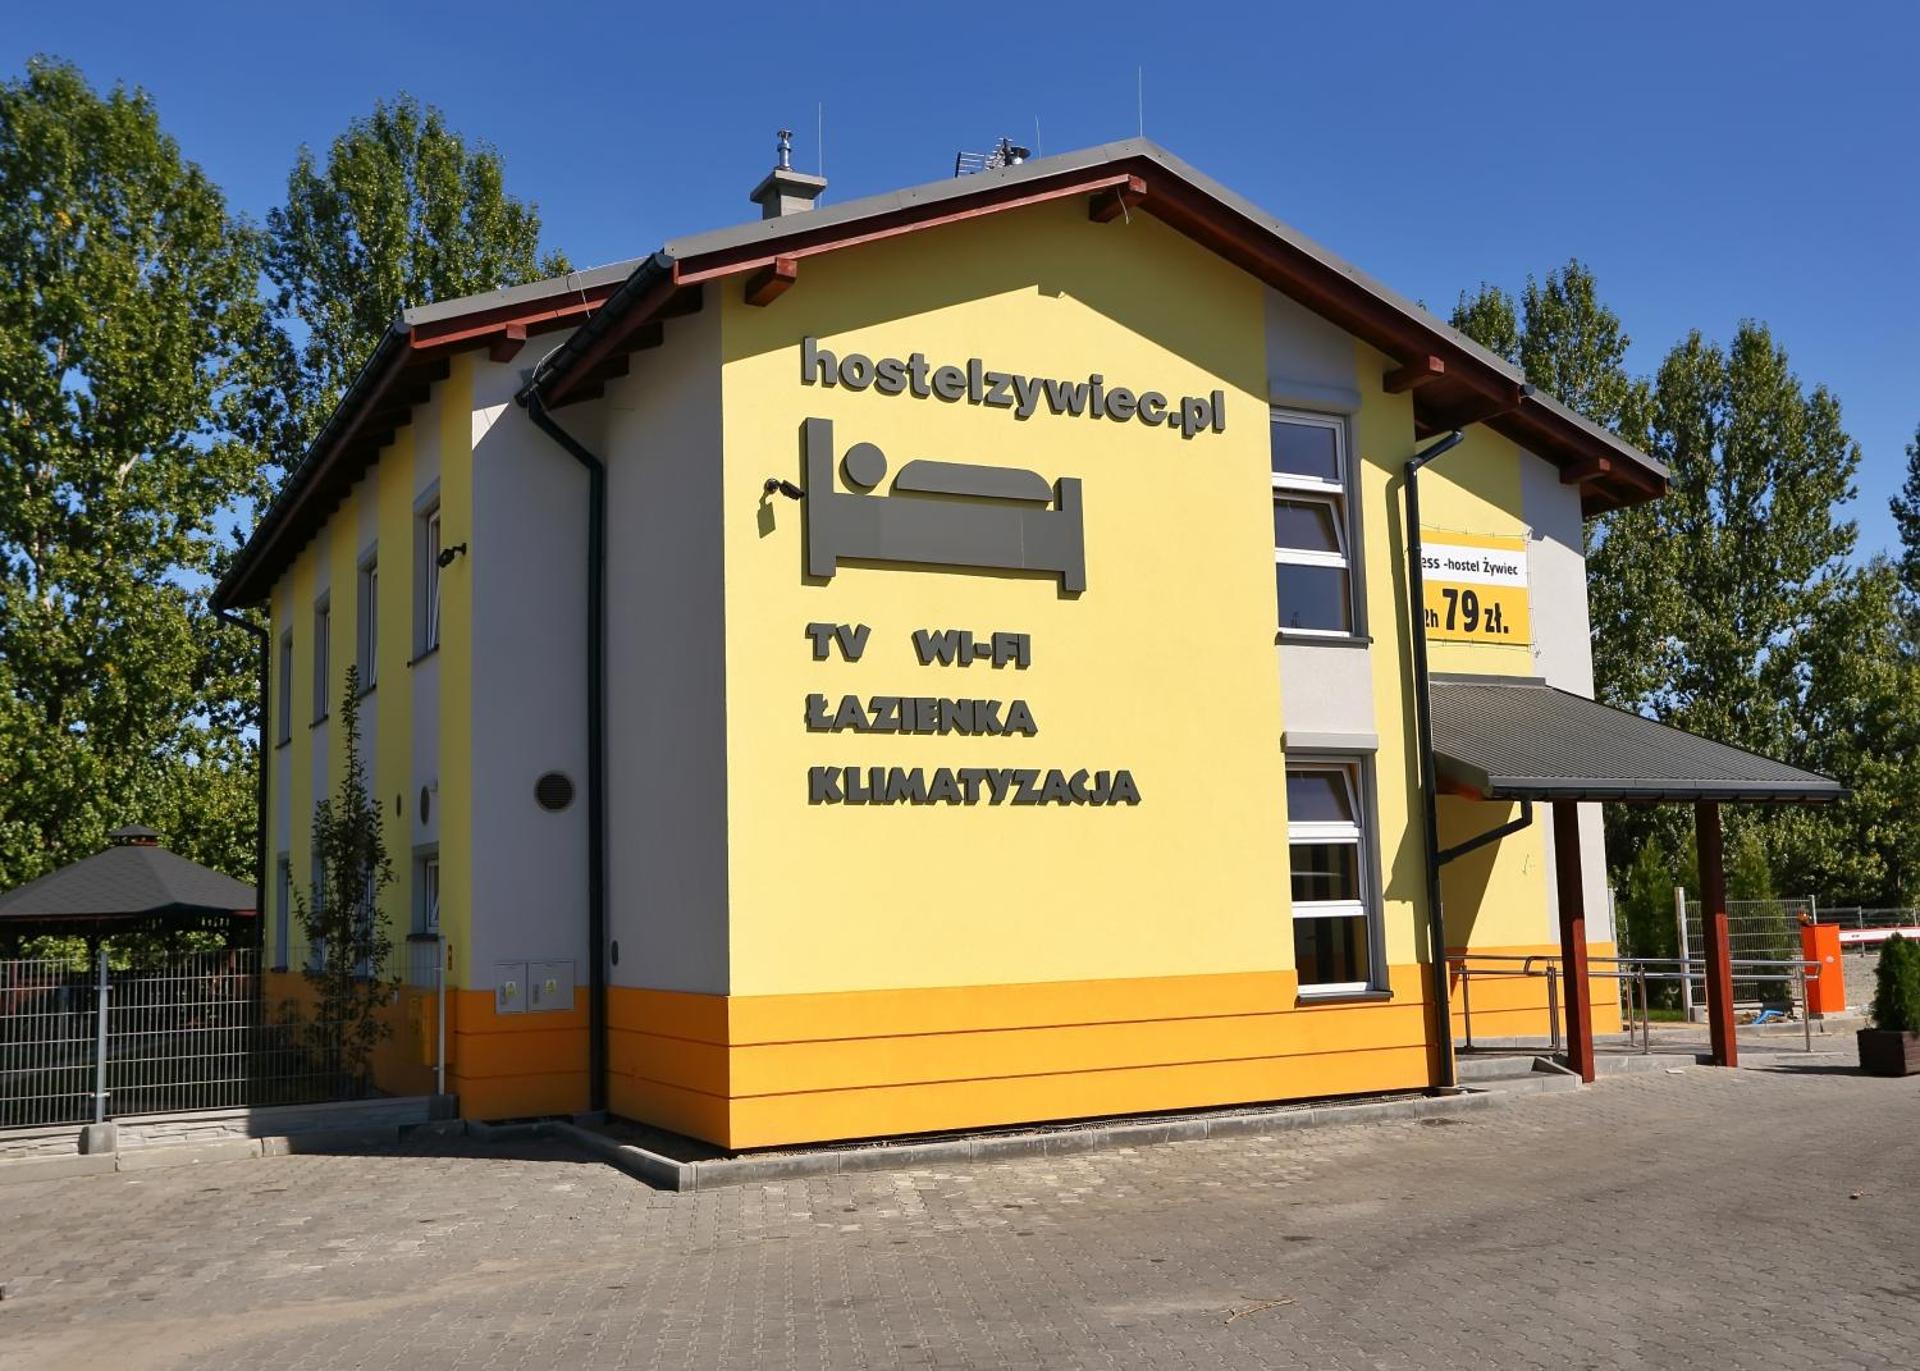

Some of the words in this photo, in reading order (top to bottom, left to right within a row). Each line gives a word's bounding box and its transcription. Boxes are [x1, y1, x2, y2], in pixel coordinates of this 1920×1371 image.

[802, 336, 1226, 440] hostelzywiec.pl
[1483, 556, 1518, 576] Żywiec
[1442, 588, 1479, 632] 79
[1484, 602, 1509, 634] zł.
[805, 622, 871, 662] TV
[911, 629, 1031, 670] WI-FI
[804, 693, 1038, 737] ŁAZIENKA
[807, 766, 1142, 806] KLIMATYZACJA
